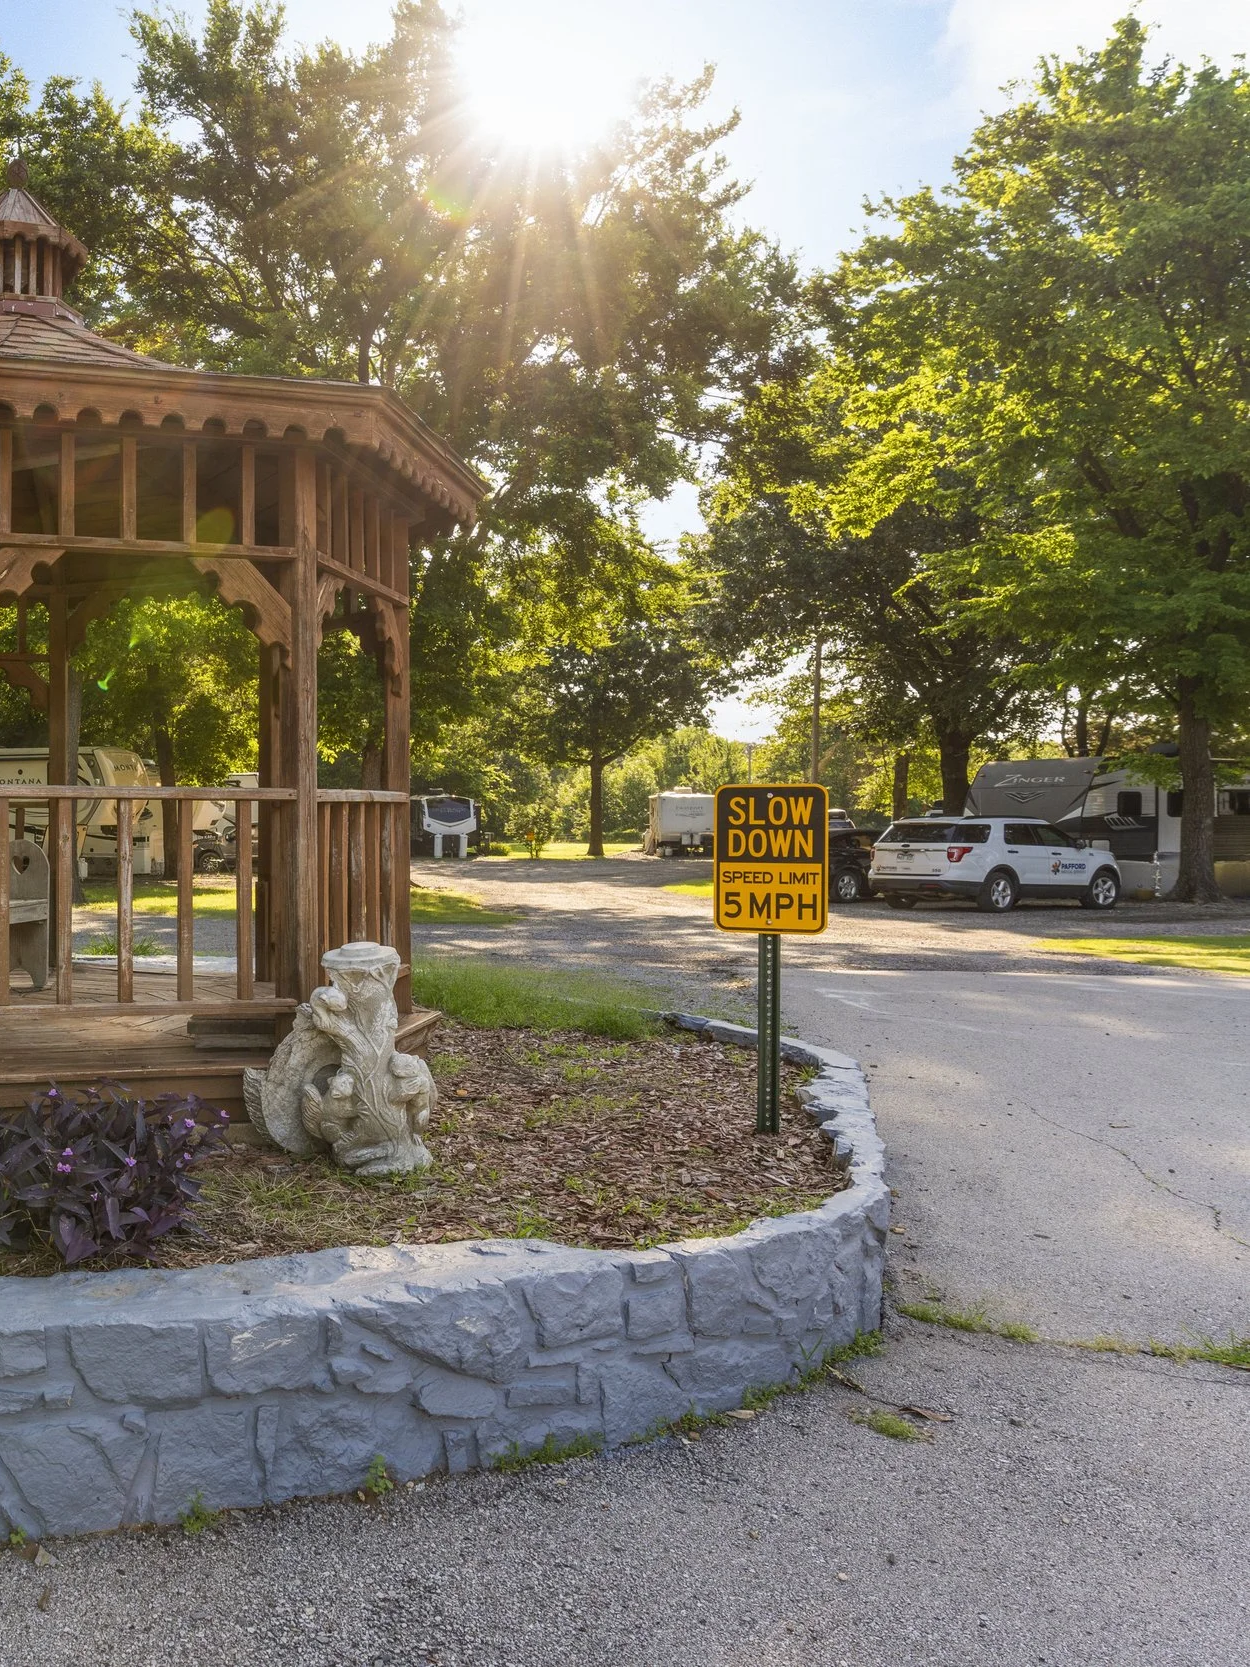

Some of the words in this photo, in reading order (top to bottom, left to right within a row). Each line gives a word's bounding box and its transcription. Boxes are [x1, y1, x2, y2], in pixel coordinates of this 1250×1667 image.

[994, 774, 1066, 788] ZINGER
[727, 796, 814, 826] SLOW
[727, 828, 814, 858] DOWN
[722, 870, 774, 884] SPEED
[779, 871, 820, 885] LIMIT
[724, 891, 743, 919] 5
[749, 891, 818, 921] MPH
